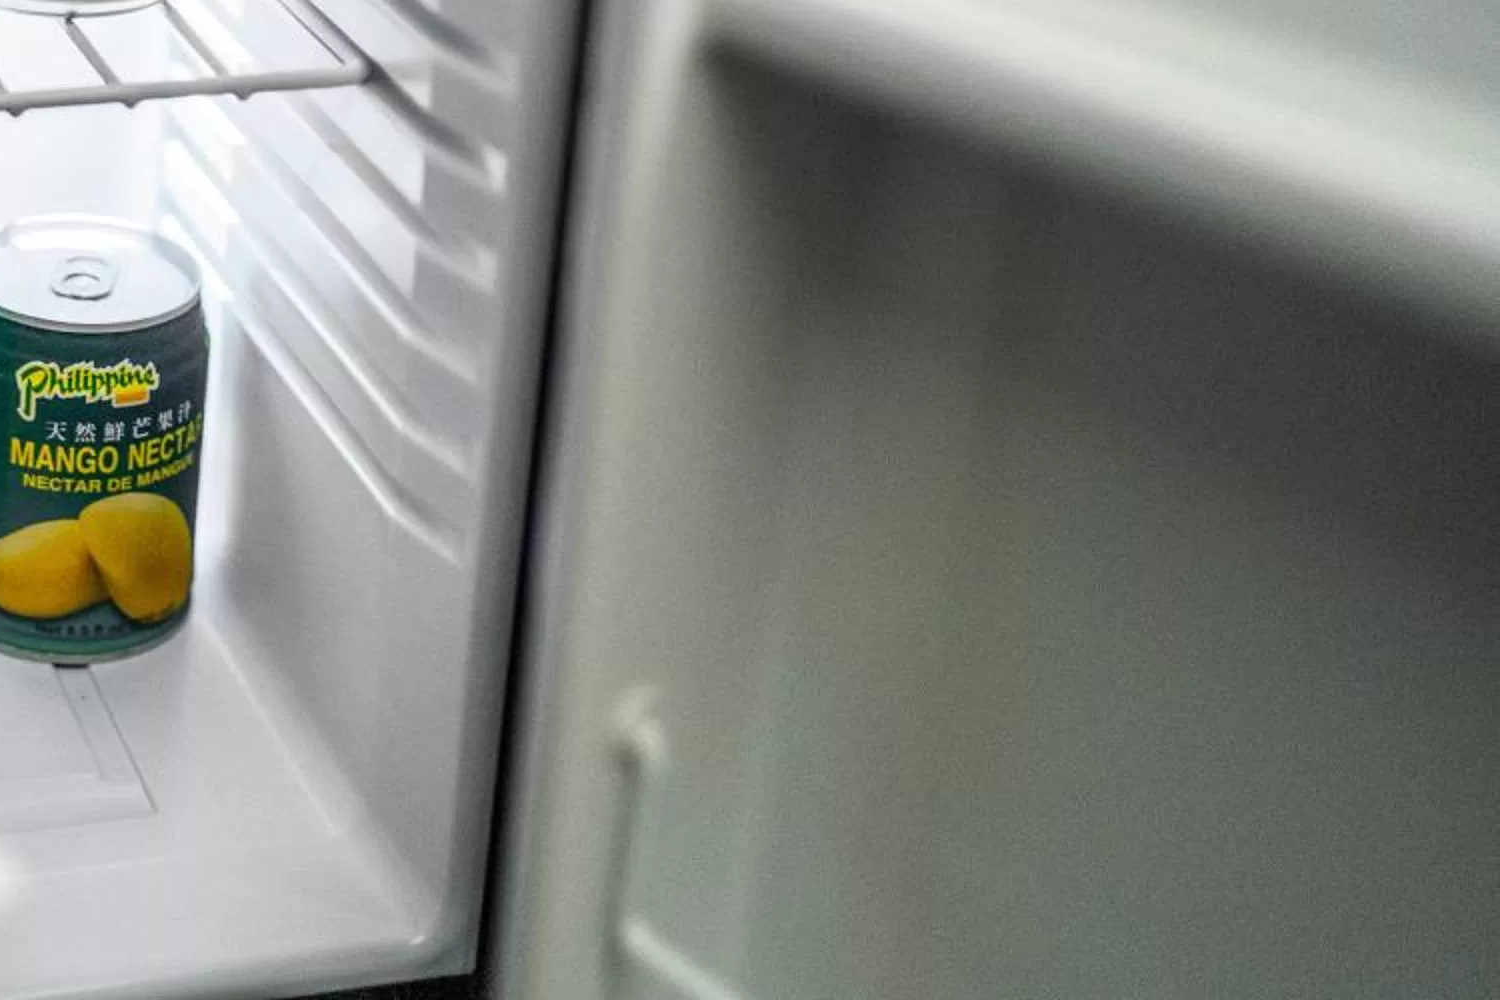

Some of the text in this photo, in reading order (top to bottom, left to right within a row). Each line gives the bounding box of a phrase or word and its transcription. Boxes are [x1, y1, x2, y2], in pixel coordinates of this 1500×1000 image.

[18, 361, 157, 419] Philippine
[10, 438, 119, 474] MANGO
[23, 473, 102, 494] NECTAR
[107, 476, 133, 493] DE
